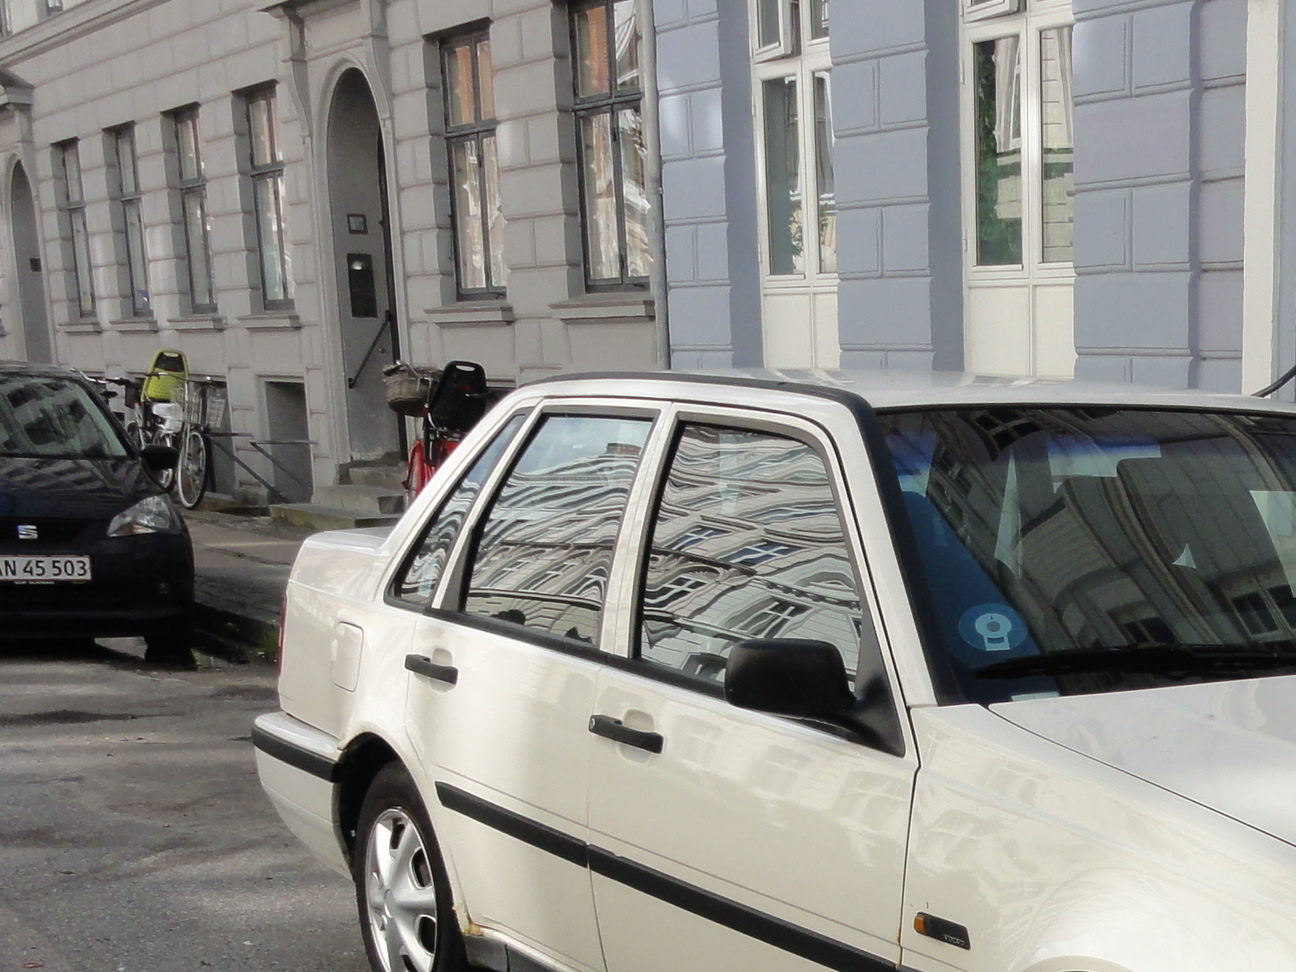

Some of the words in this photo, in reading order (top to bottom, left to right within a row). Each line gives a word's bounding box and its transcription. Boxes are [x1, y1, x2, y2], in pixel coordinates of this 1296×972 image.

[0, 560, 17, 576] N
[22, 560, 46, 576] 45
[52, 560, 87, 576] 503
